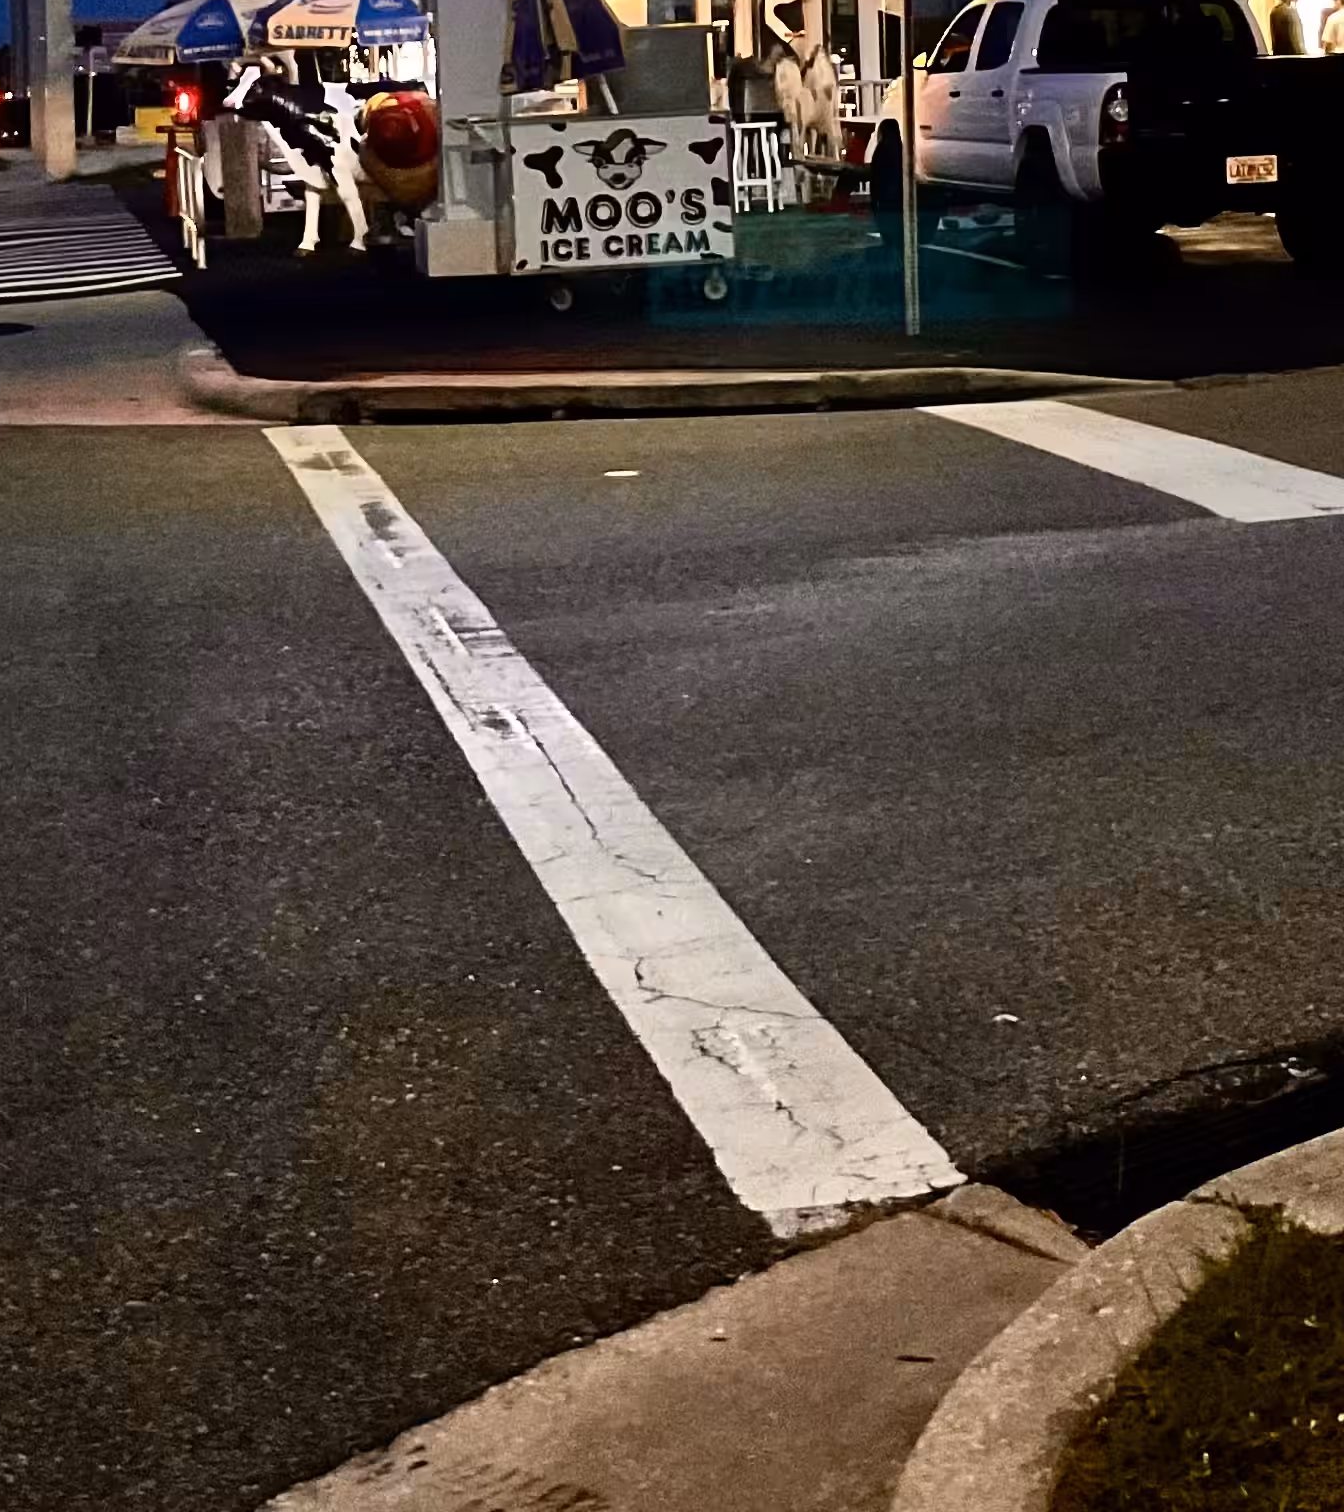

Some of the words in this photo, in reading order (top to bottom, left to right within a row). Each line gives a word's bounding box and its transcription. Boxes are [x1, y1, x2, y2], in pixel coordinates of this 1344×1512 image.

[541, 188, 707, 234] MOO'S
[540, 238, 591, 262] ICE
[602, 229, 711, 258] CREAM
